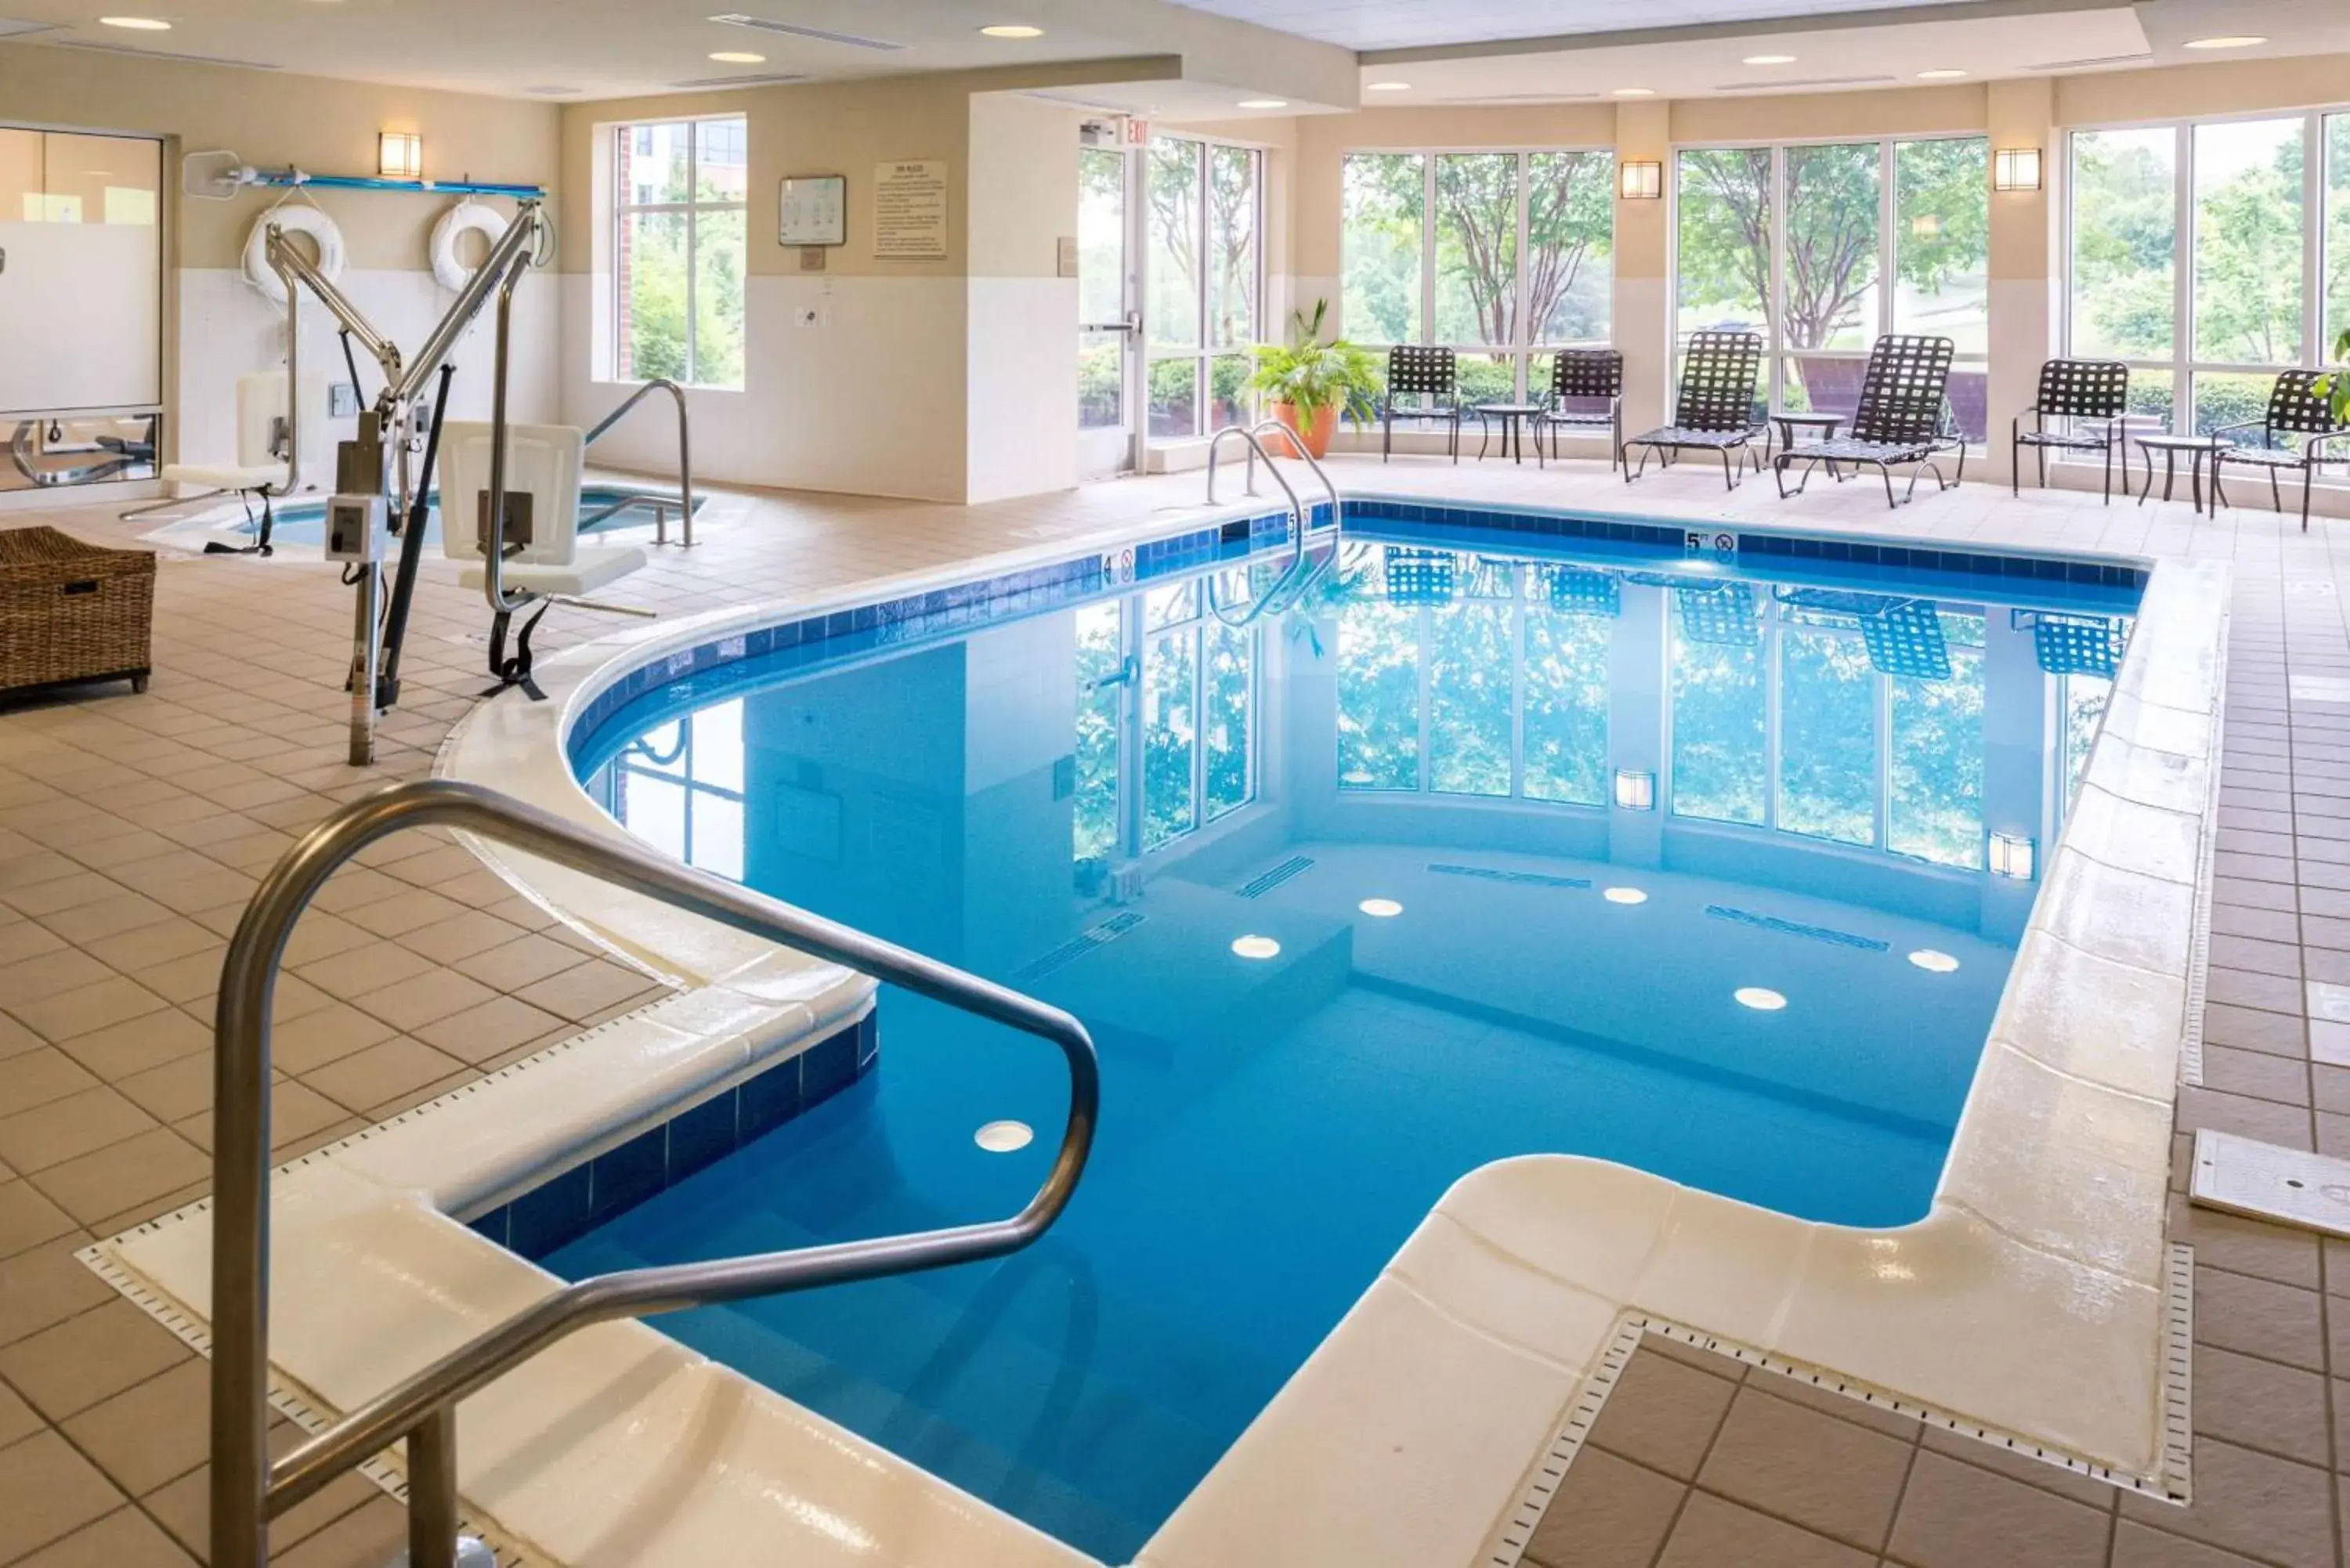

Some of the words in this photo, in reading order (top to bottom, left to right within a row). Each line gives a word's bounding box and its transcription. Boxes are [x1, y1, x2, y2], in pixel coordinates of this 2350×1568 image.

[1128, 119, 1148, 145] EXIT
[1687, 533, 1700, 550] 5
[1104, 556, 1111, 571] 4
